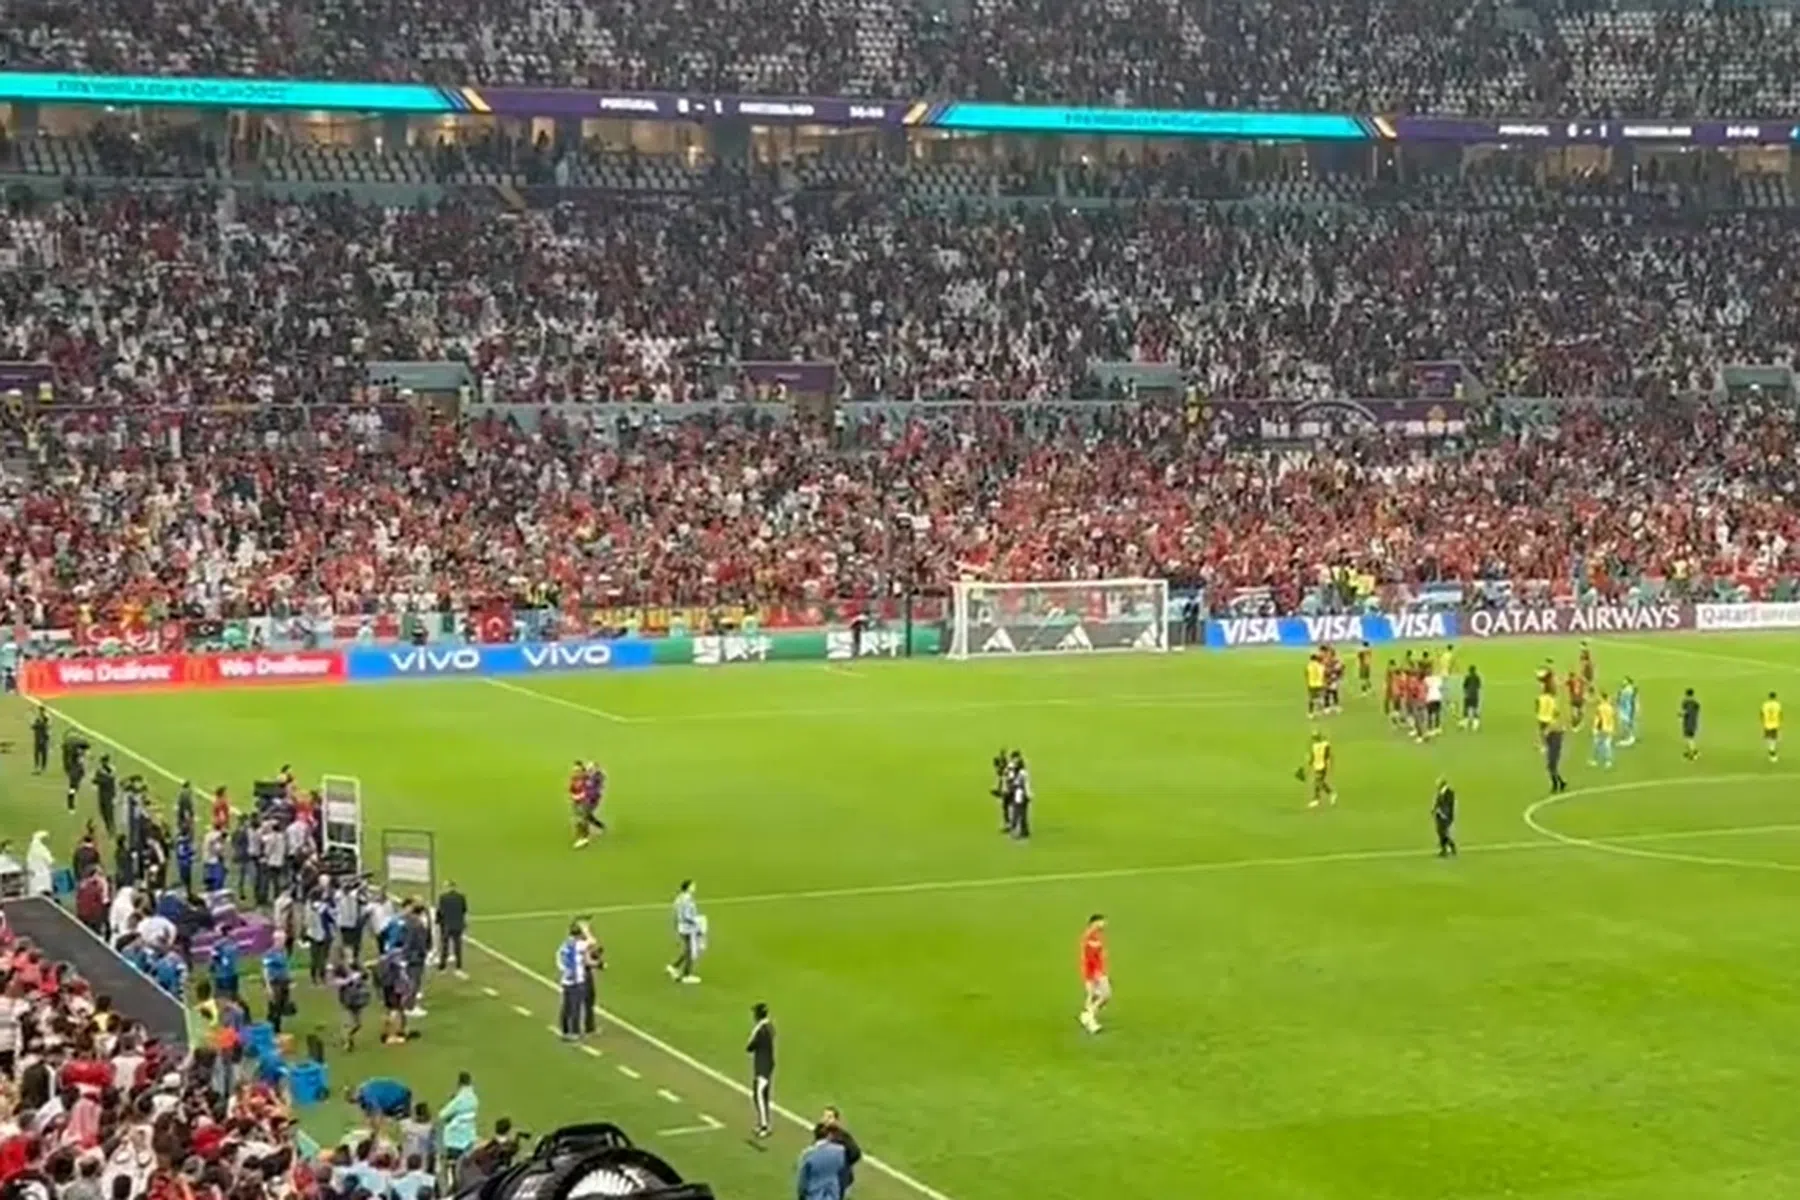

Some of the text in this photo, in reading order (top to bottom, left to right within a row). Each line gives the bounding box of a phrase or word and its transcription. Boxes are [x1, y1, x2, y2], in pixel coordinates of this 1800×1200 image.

[1221, 618, 1281, 644] VISA
[1304, 615, 1364, 641] VISA
[1384, 612, 1447, 637] VISA
[1470, 605, 1680, 635] QATAR AIRWAYS
[59, 664, 94, 683] We
